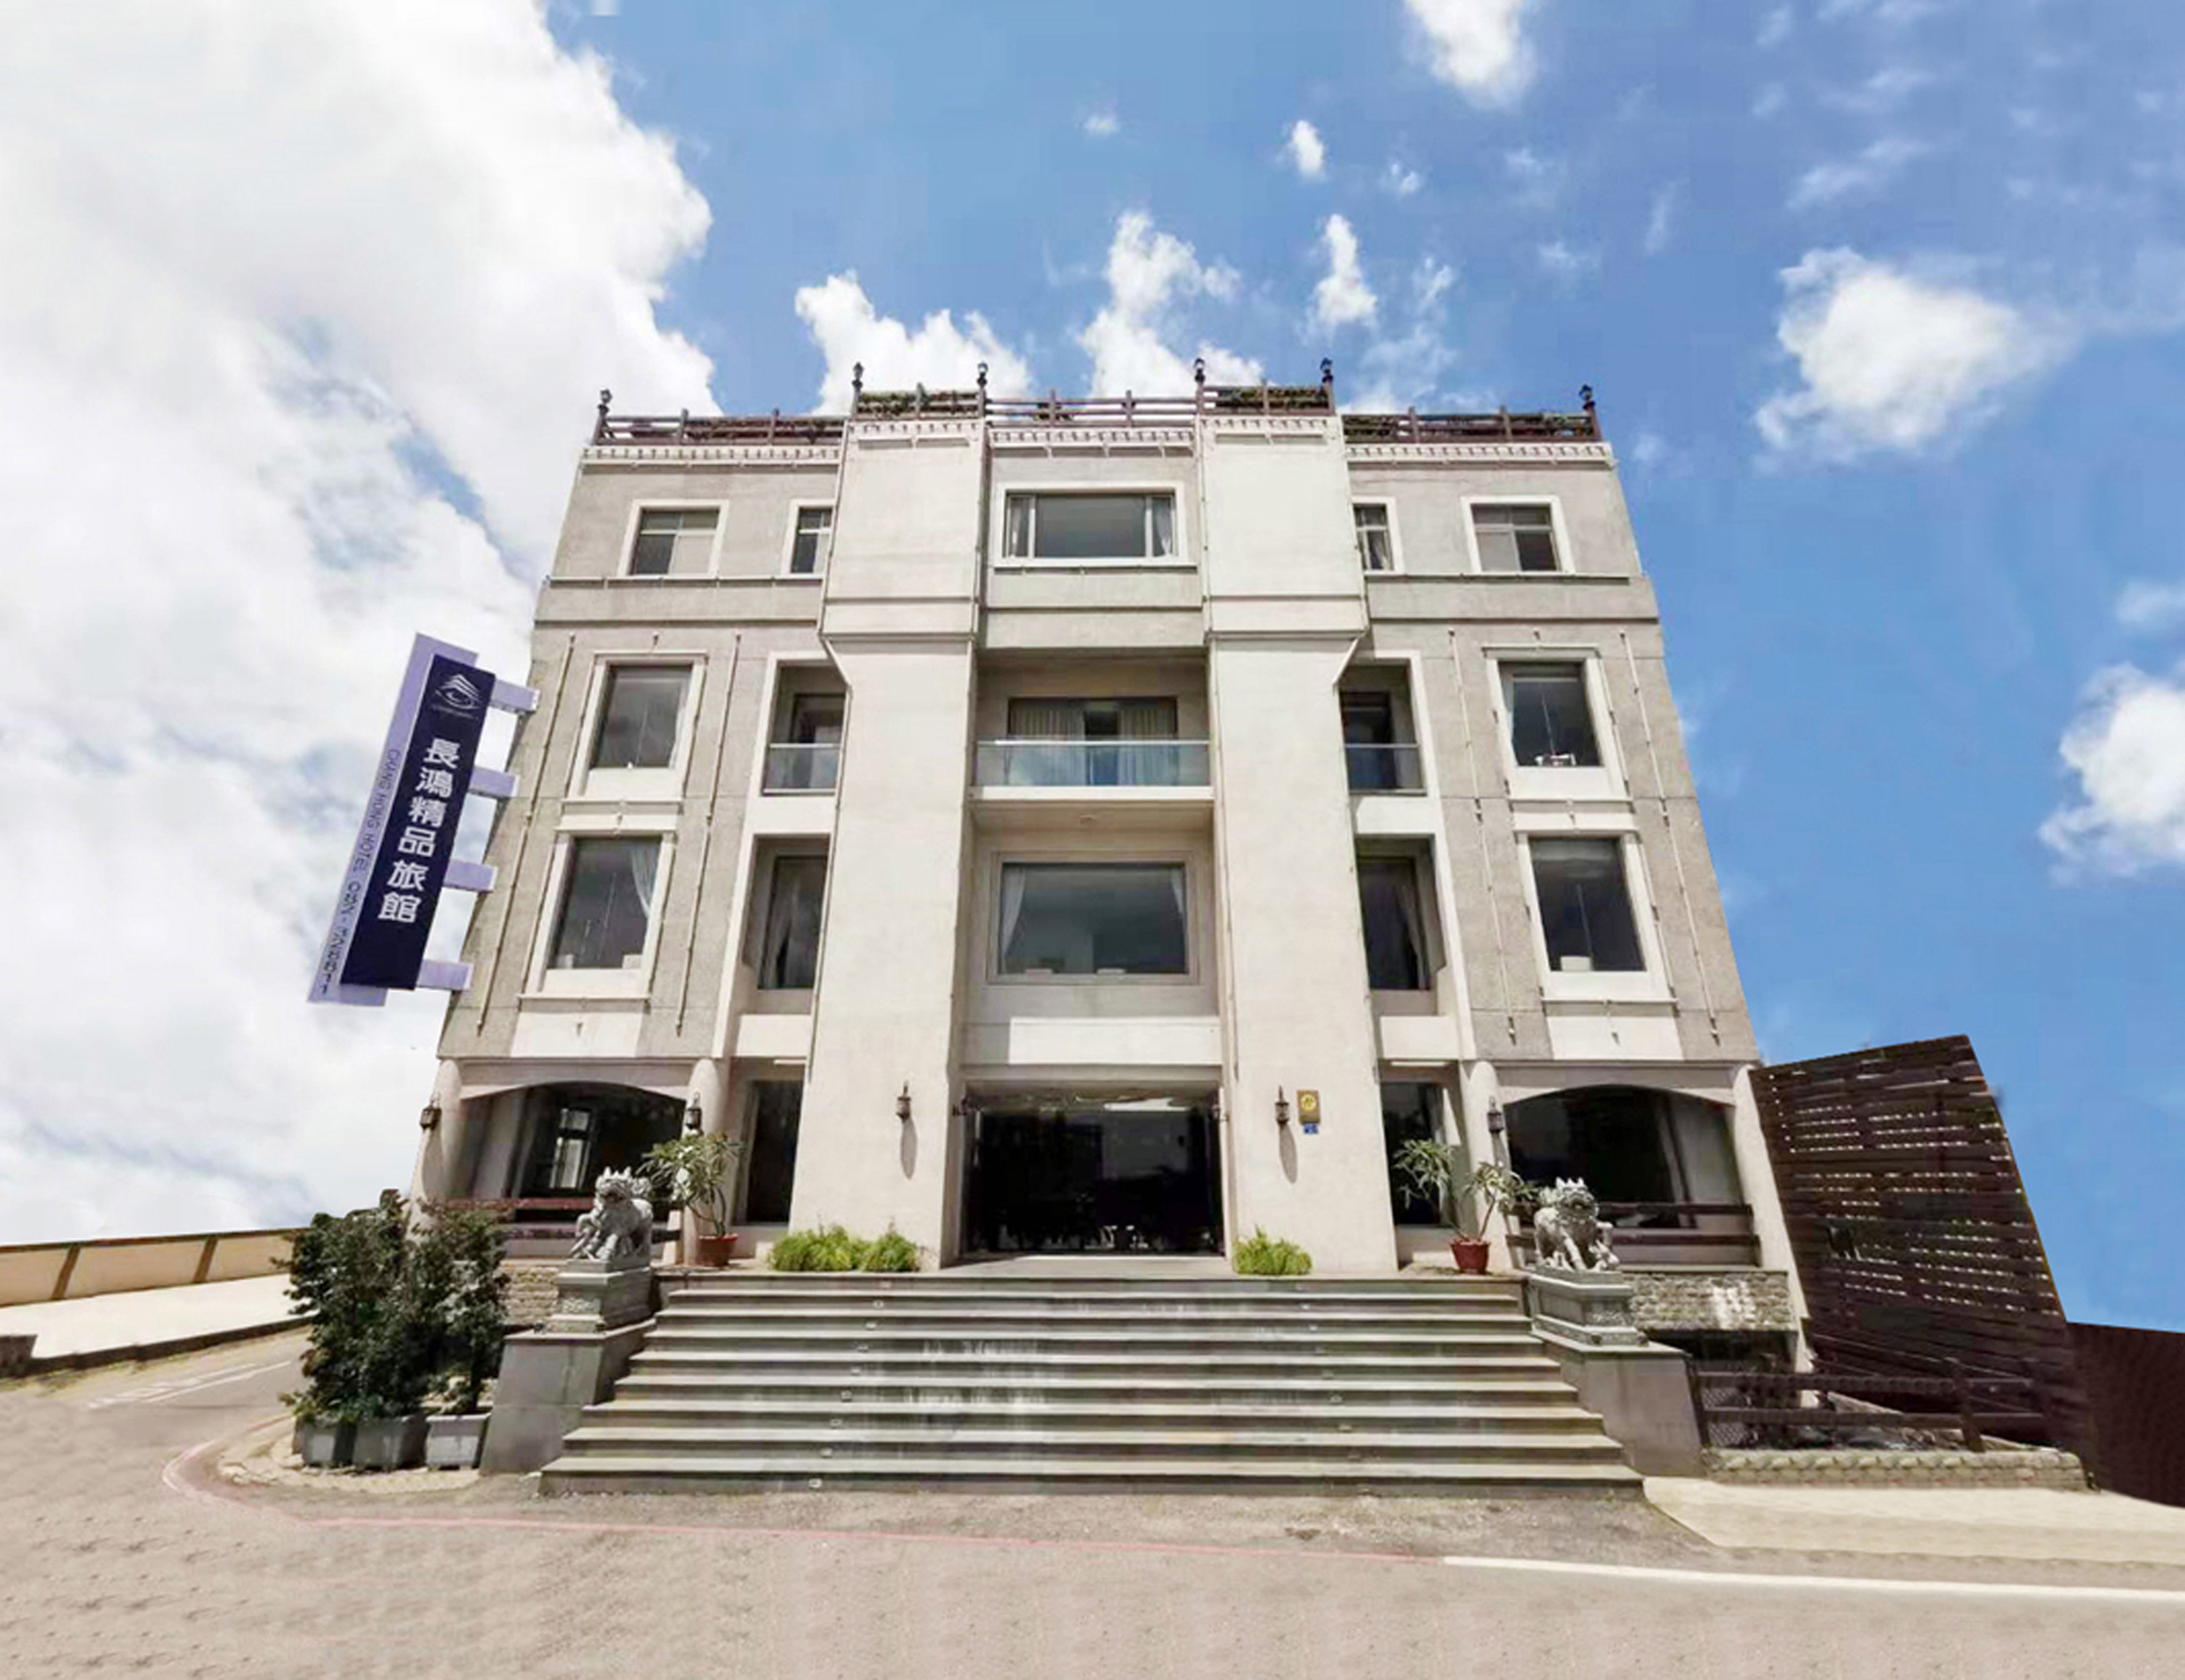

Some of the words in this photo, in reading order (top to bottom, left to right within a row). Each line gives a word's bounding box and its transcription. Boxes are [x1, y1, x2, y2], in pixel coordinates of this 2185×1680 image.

[379, 749, 400, 790] CHANG
[366, 792, 387, 829] HONG
[377, 737, 460, 923] 長鴻精品旅館
[353, 832, 375, 872] HOTEL
